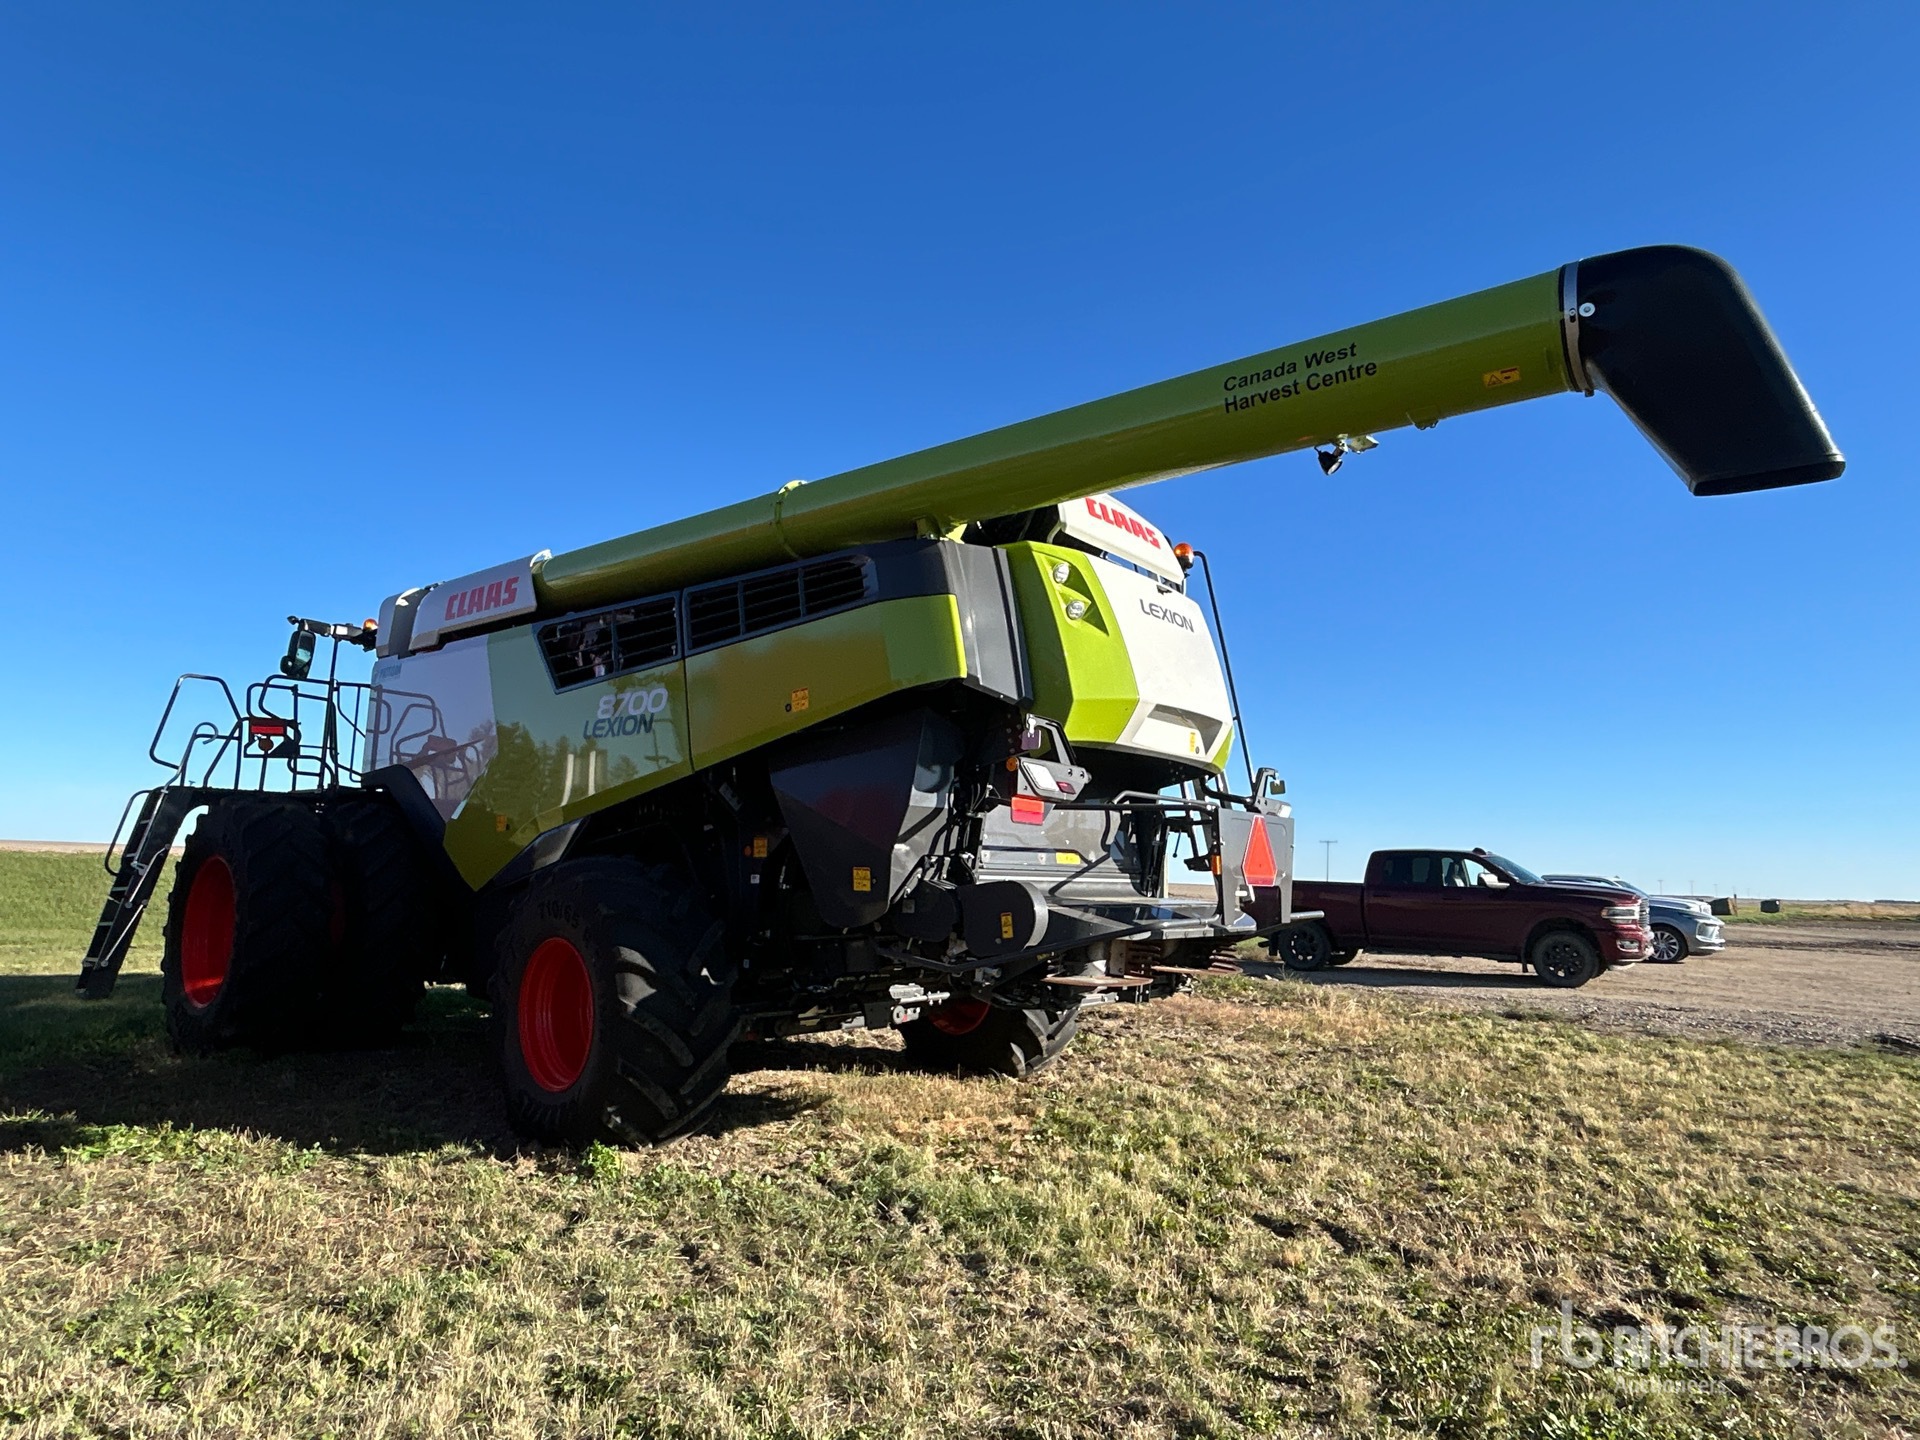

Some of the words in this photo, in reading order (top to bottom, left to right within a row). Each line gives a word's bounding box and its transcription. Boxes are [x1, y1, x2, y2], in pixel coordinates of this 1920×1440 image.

[1223, 361, 1298, 391] Canada
[1304, 342, 1357, 369] West
[1224, 379, 1300, 413] Harvest
[1306, 362, 1377, 391] Centre
[1085, 496, 1161, 549] CLAAS
[445, 576, 519, 621] CLAAS
[1139, 598, 1195, 633] LEXION
[583, 712, 655, 739] LEXION
[597, 687, 668, 719] 8700
